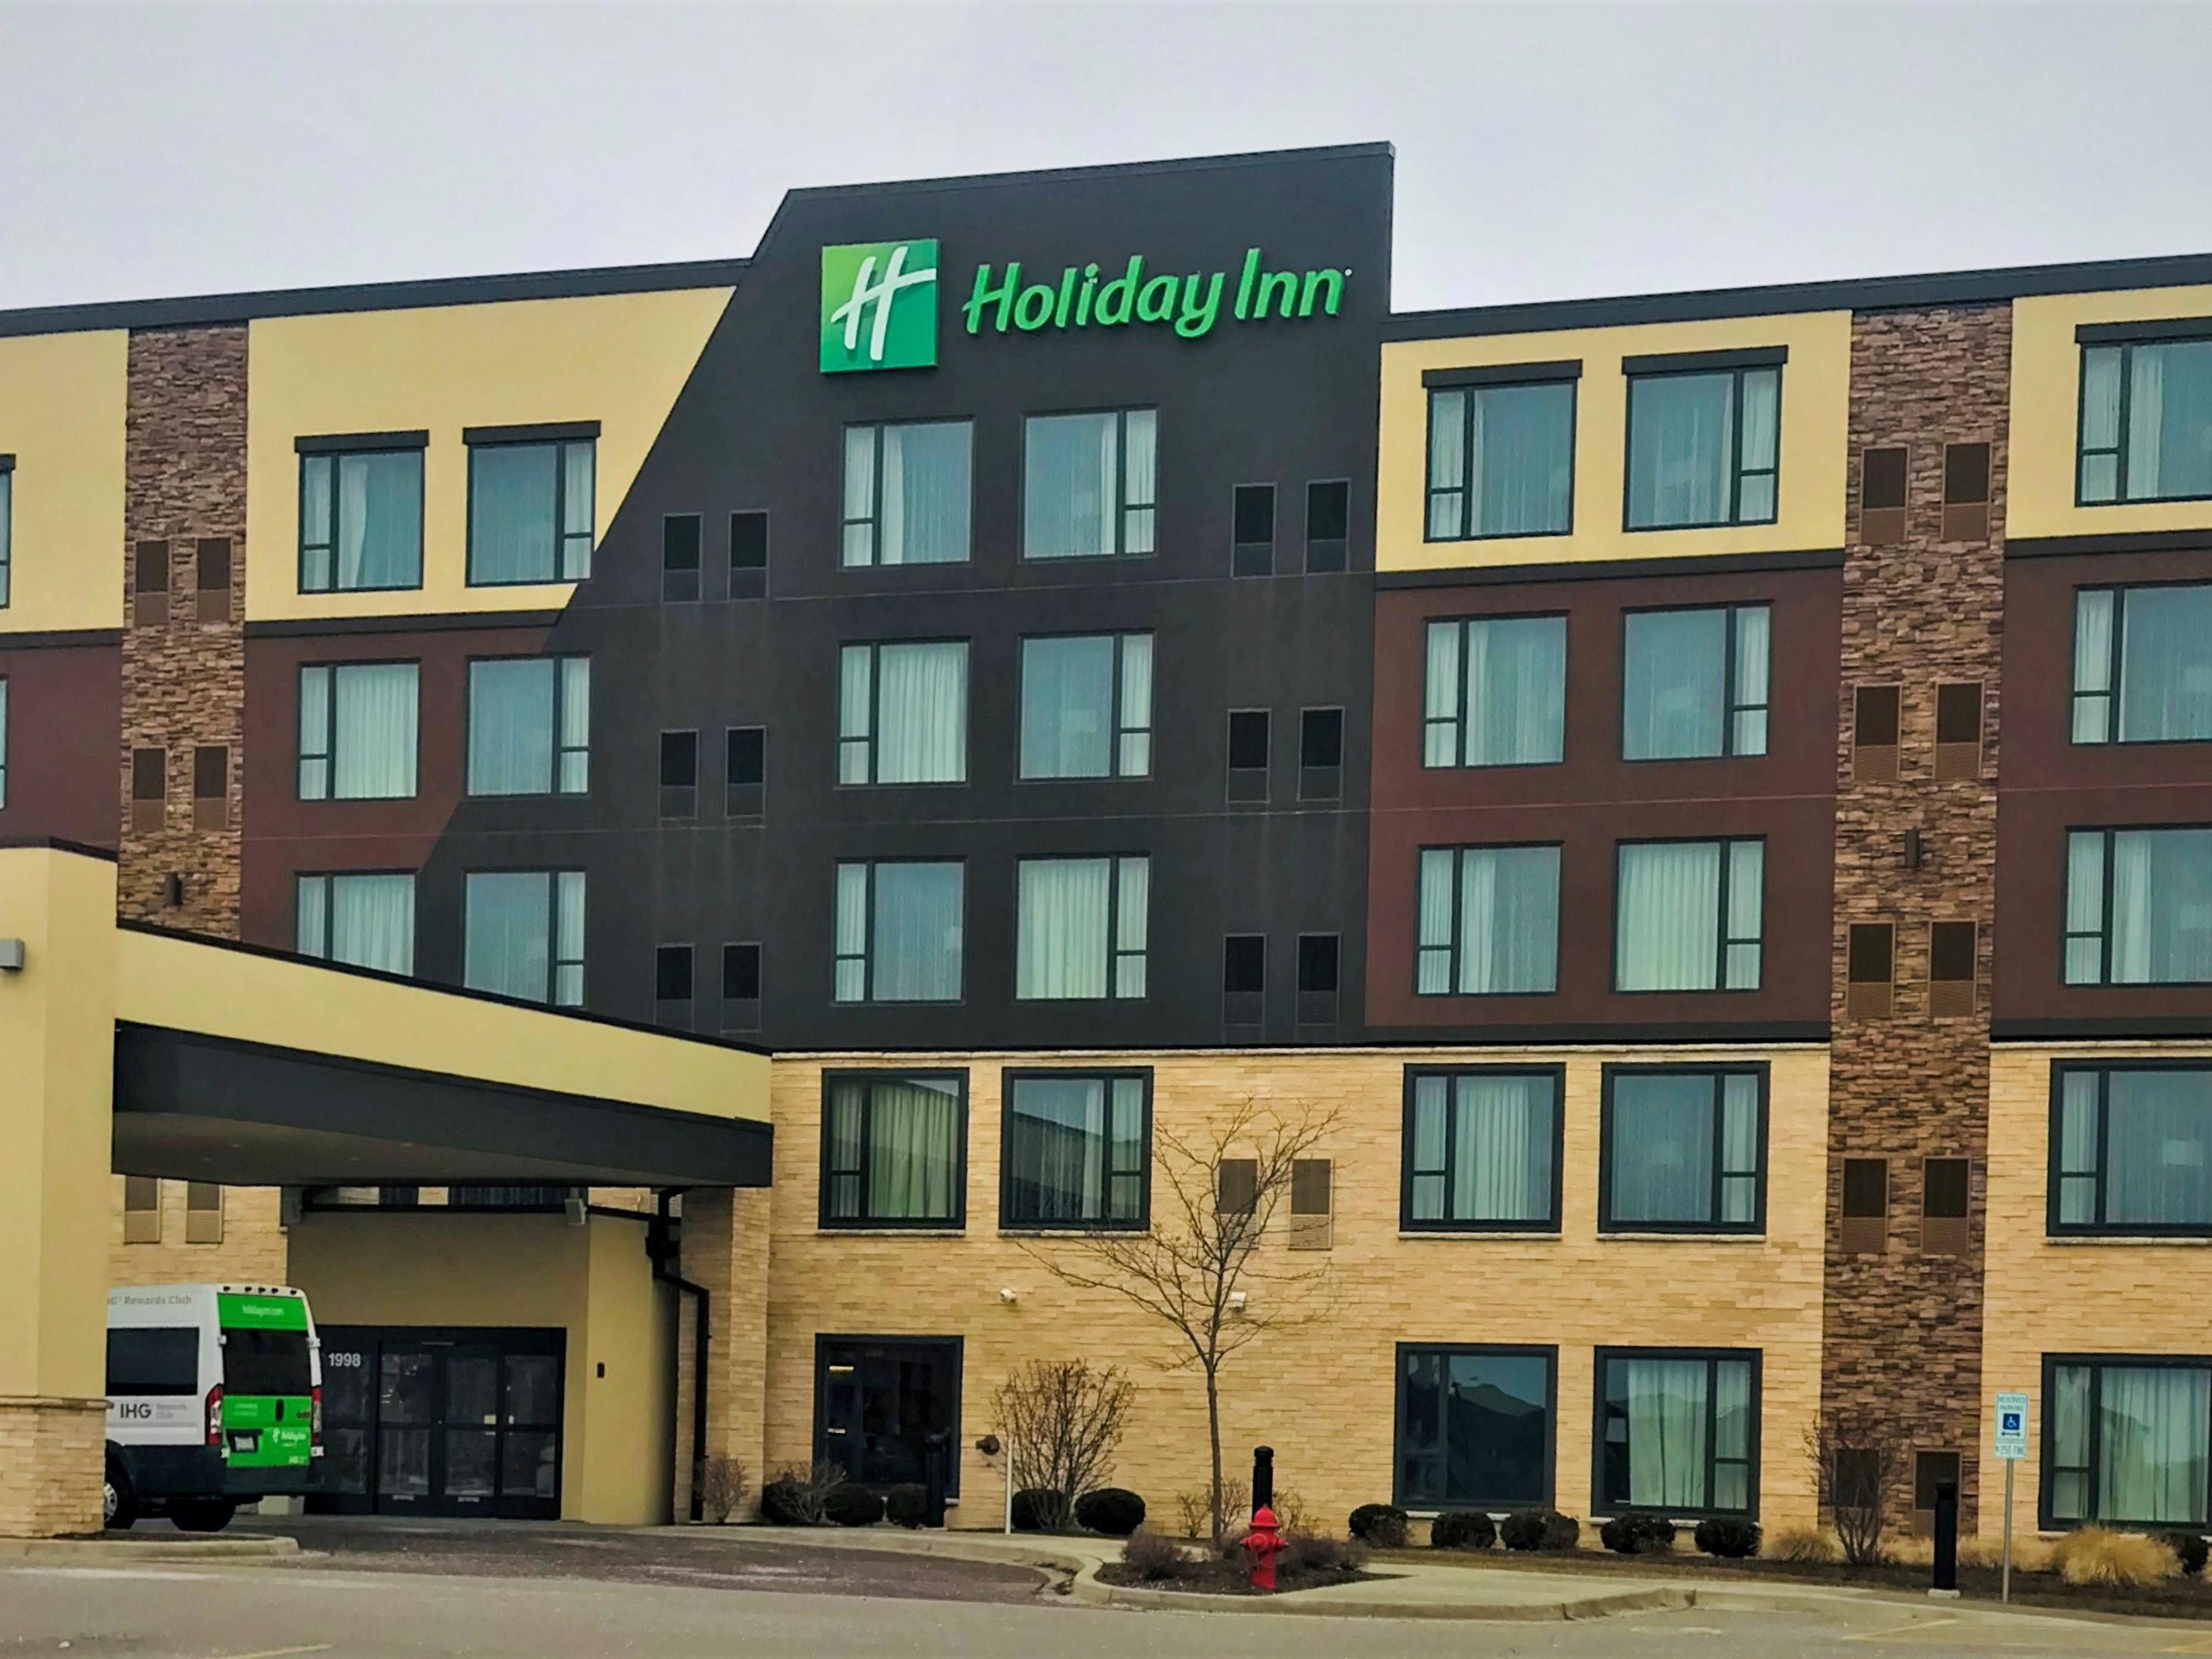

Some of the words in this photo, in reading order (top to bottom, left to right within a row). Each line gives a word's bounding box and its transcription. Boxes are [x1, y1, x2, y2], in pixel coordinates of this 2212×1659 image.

[962, 255, 1225, 338] Holiday
[1234, 248, 1346, 320] Inn
[168, 1294, 192, 1305] Club
[328, 1352, 361, 1367] 1998
[120, 1403, 152, 1419] IHG
